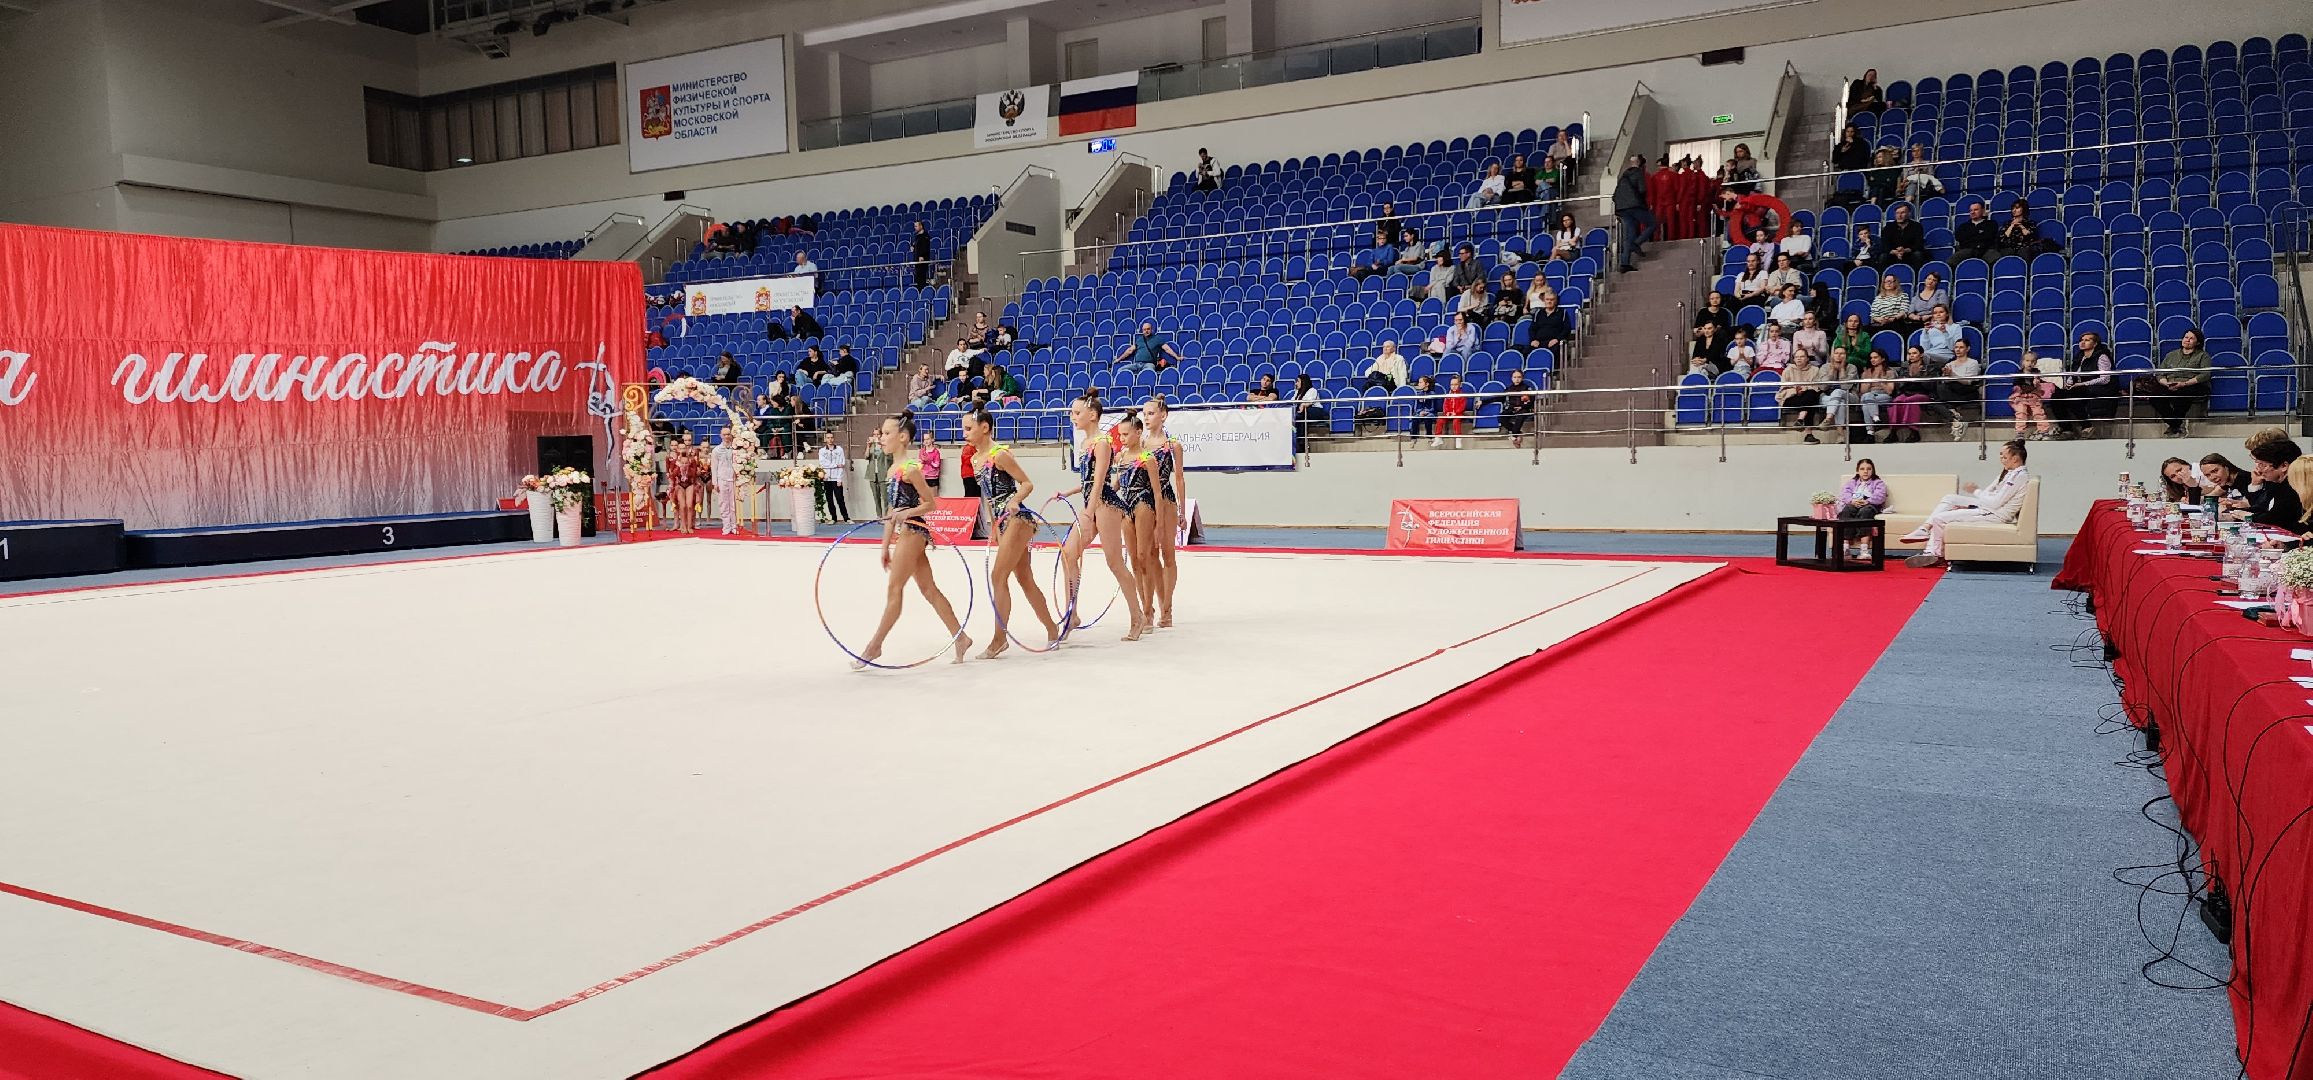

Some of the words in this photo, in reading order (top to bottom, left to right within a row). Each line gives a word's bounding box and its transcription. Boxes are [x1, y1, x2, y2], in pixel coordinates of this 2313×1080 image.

[672, 72, 748, 92] МИНИСТЕРСТВО
[672, 84, 737, 104] ФИЗИЧЕСКОЙ
[673, 102, 720, 116] КУЛЬТУРЫ
[723, 100, 730, 108] И
[732, 93, 771, 106] СПОРТА
[673, 109, 739, 128] МОСКОВСКОЙ
[674, 126, 718, 139] ОБЛАСТИ
[111, 341, 567, 404] гимнастика
[1215, 431, 1270, 443] ФЕДЕРАЦИЯ
[1427, 519, 1480, 527] ФЕДЕРАЦИЯ
[1429, 510, 1502, 518] ВСЕРОССИЙСКАЯ
[382, 527, 395, 546] 3
[1426, 528, 1509, 536] ХУДОЖЕСТВЕННОЙ
